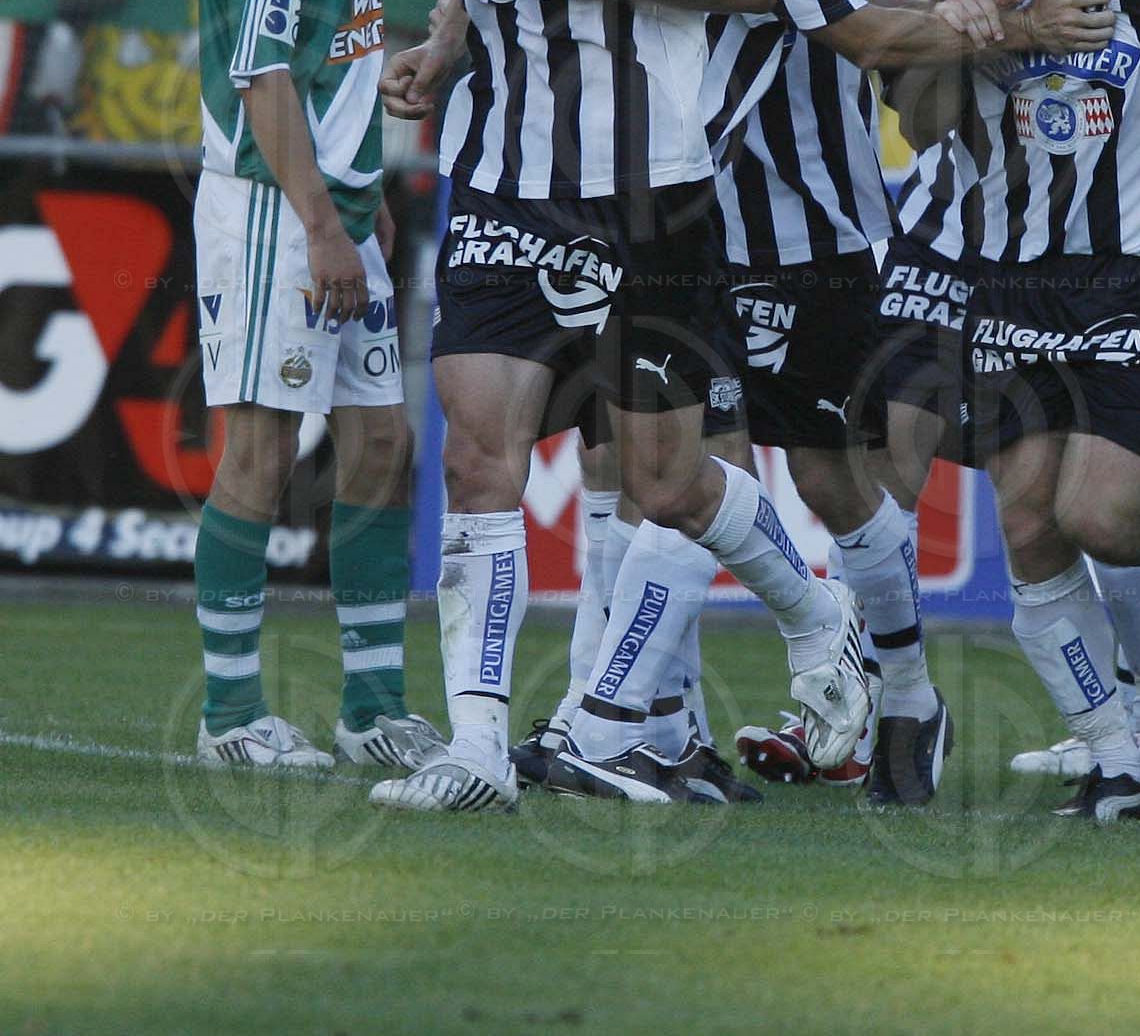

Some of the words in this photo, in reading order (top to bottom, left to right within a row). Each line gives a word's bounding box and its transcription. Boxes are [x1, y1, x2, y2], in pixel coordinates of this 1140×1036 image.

[885, 265, 974, 305] FLUG
[597, 585, 666, 696] PUNTIGAMER
[1066, 643, 1105, 706] IGAMER
